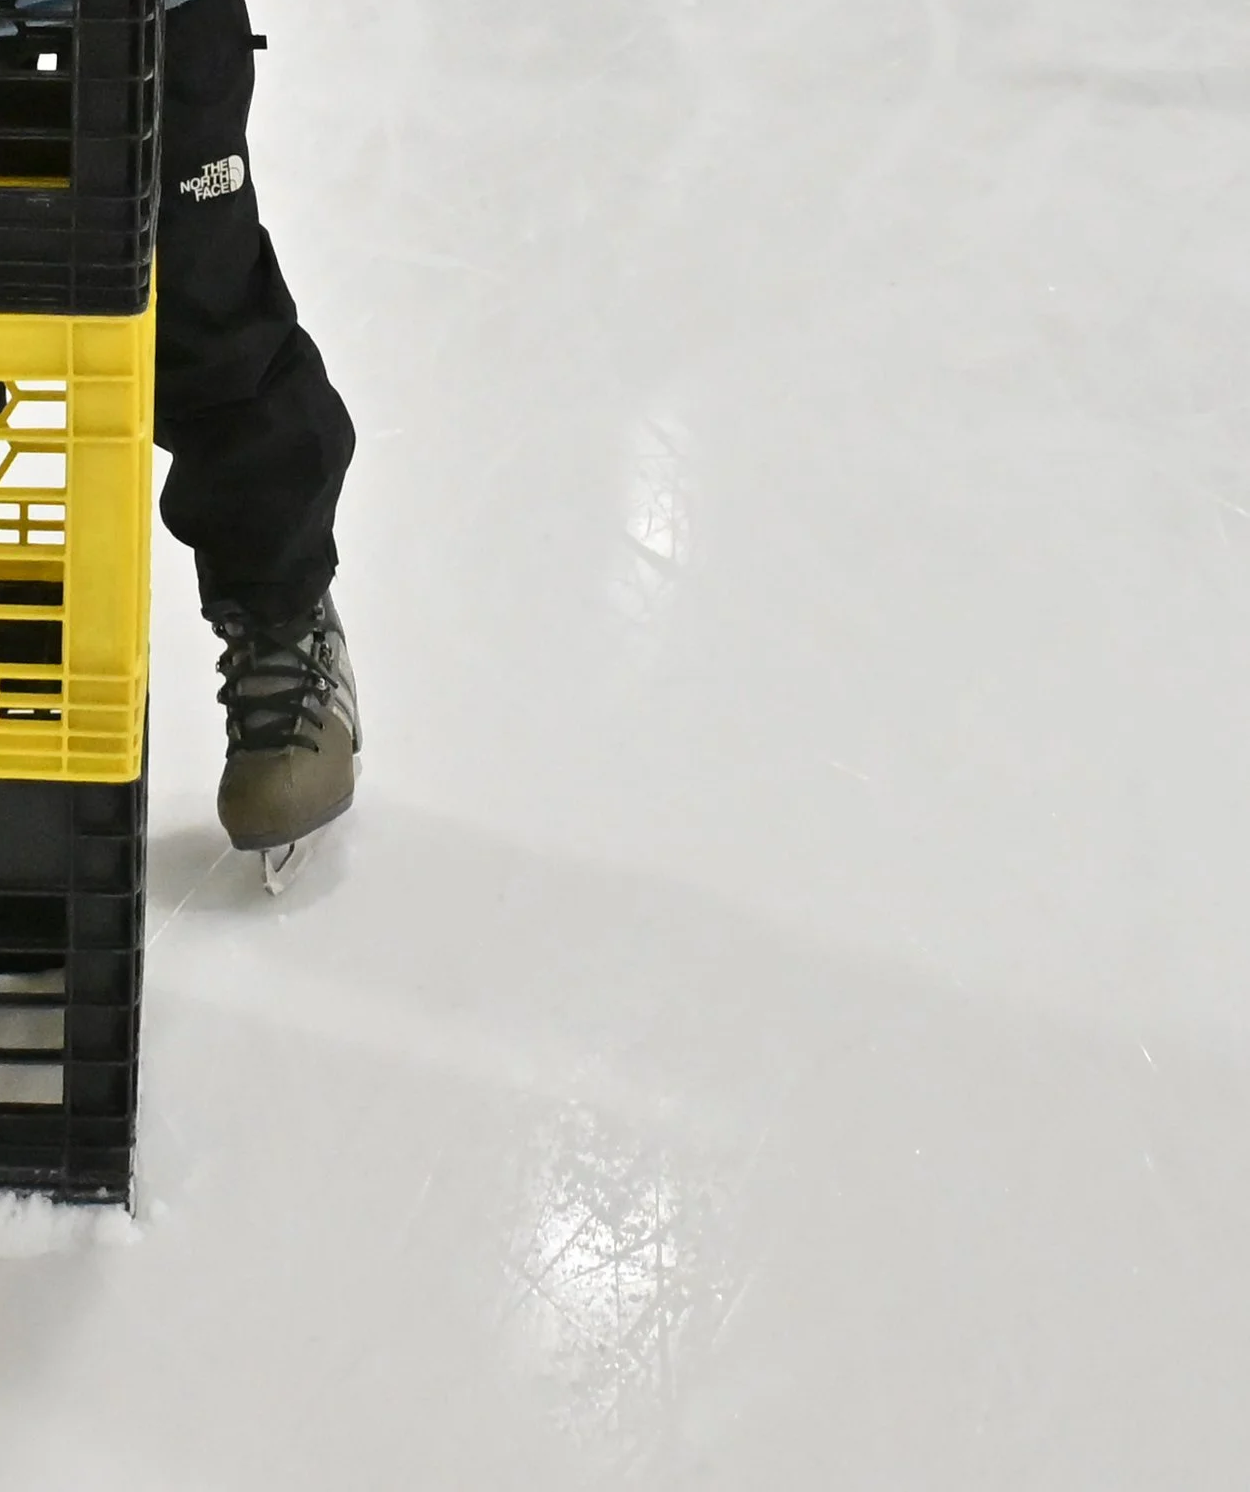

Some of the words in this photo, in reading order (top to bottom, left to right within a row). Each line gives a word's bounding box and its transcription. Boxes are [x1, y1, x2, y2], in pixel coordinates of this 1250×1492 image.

[201, 158, 229, 178] THE
[179, 171, 230, 195] NORTH
[194, 182, 231, 203] FACE
